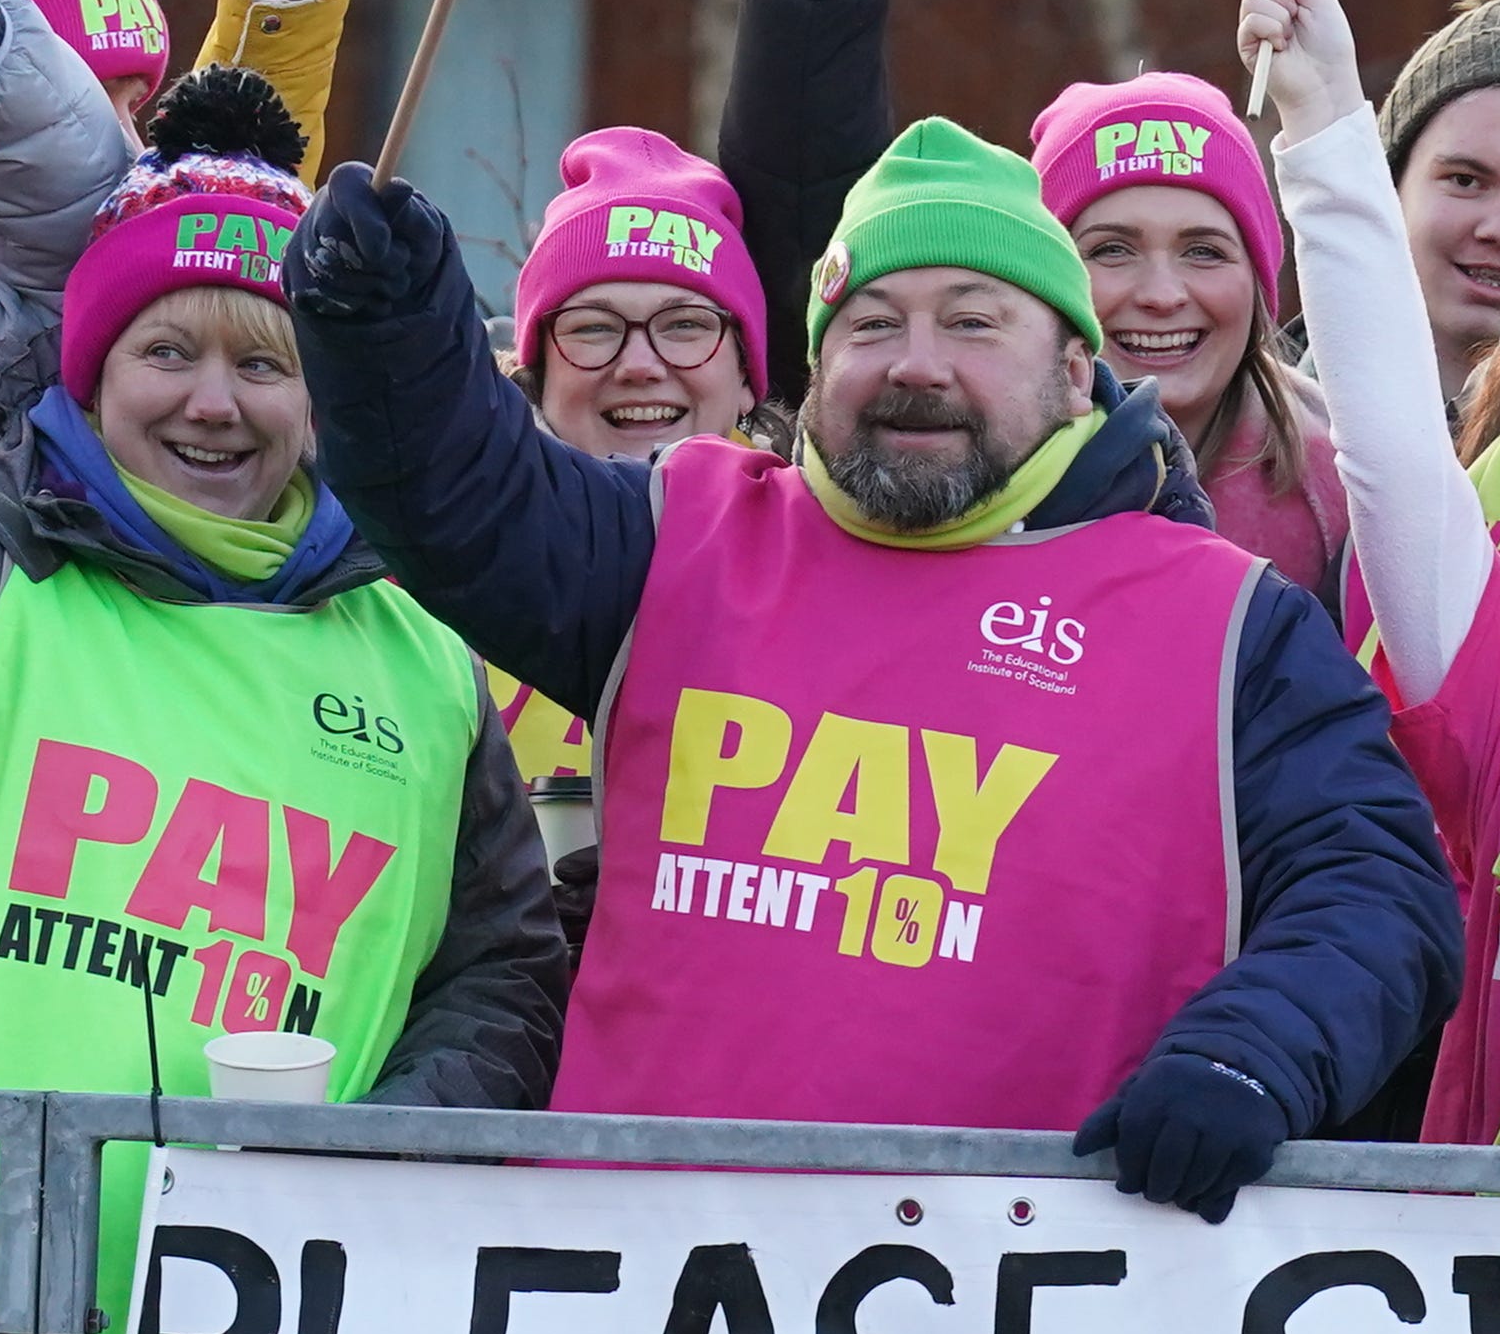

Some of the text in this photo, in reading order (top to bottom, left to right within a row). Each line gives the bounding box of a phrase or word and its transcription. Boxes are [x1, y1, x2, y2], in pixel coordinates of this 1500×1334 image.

[1094, 120, 1211, 168] PAY
[176, 213, 293, 262] PAY
[605, 206, 723, 263] PAY
[980, 595, 1086, 665] eis
[967, 660, 1077, 695] Institute of Scotland
[981, 648, 1069, 681] The Educational
[313, 692, 404, 755] eis
[659, 688, 1060, 895] PAY
[8, 738, 398, 979] PAY
